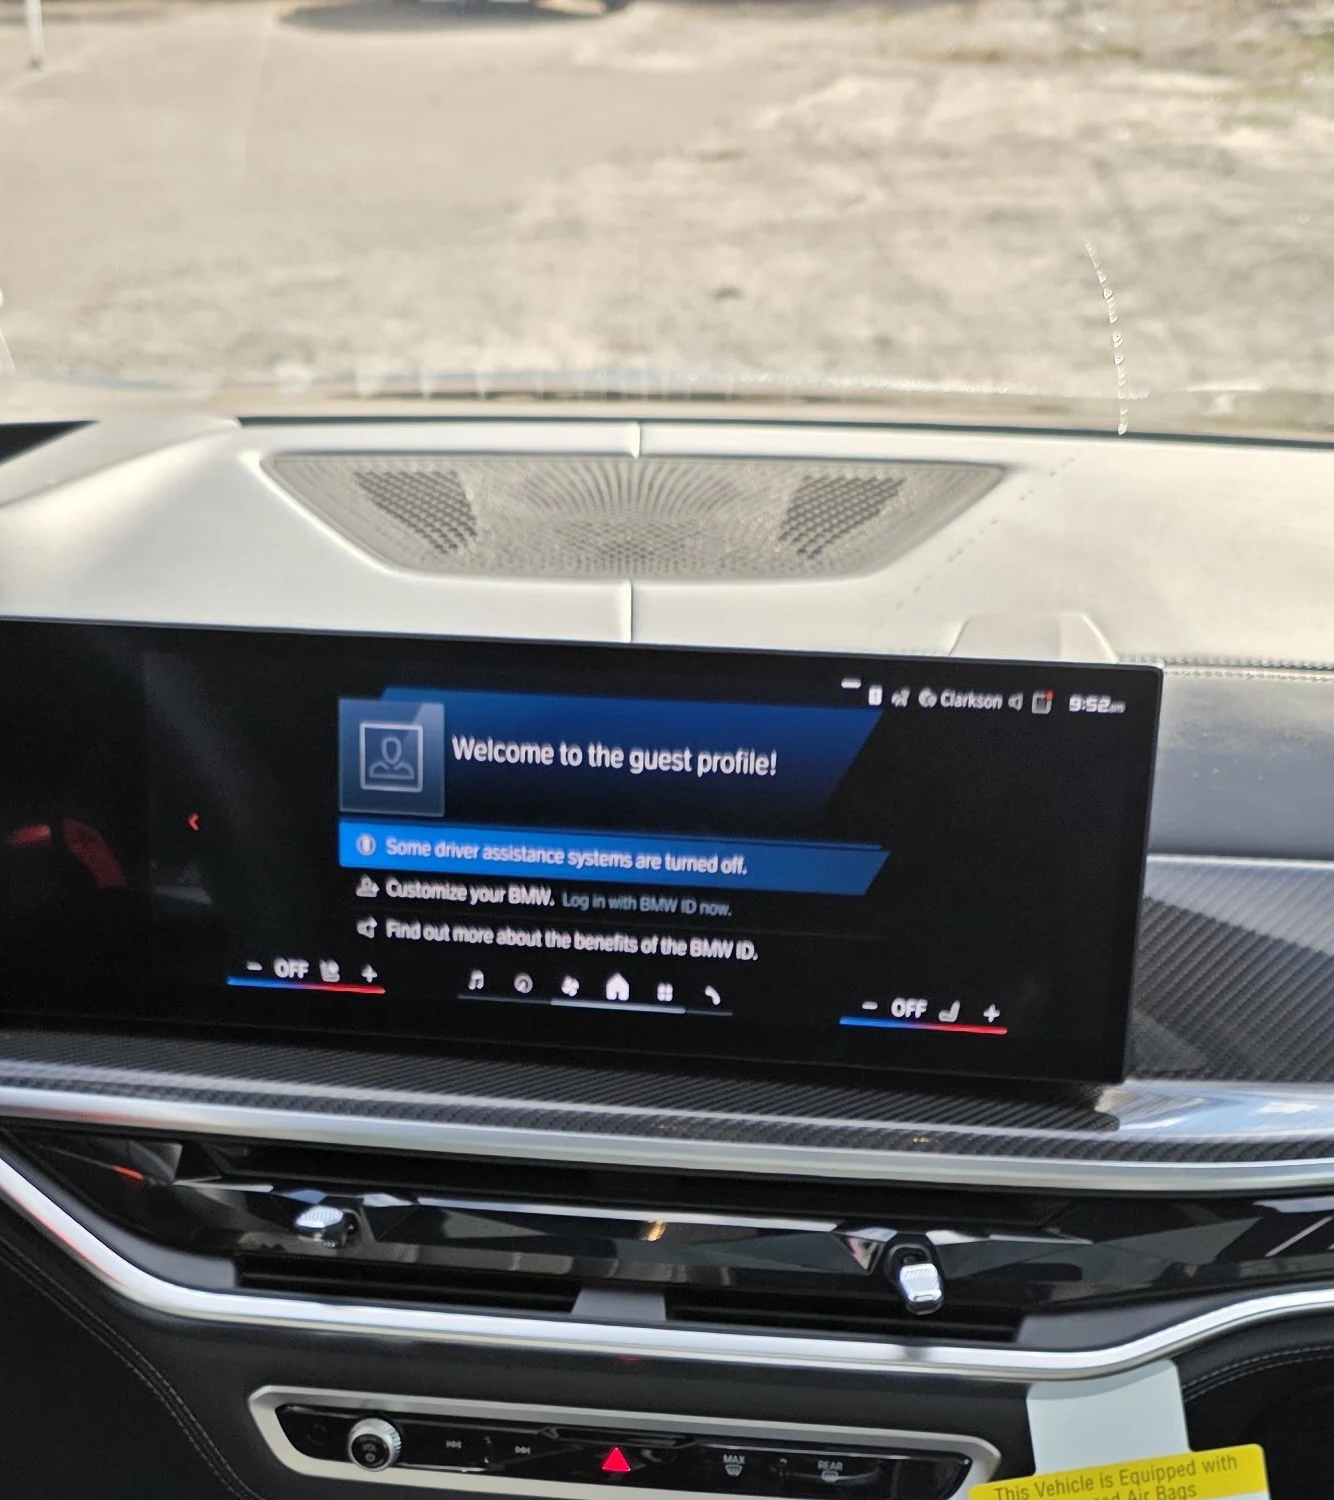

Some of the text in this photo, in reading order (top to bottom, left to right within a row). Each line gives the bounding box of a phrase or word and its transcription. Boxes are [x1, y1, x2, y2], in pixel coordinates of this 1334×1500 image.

[940, 688, 1003, 710] Clarkson
[452, 735, 777, 777] Welcome to the guest profile!
[386, 835, 747, 875] Some driver assistance systems are turned off.
[386, 877, 555, 907] Customize your BMW.
[562, 891, 732, 916] Log in with BMW ID now.
[386, 918, 759, 961] Find out more about the benefits of the BMW ID.
[274, 958, 309, 979] OFF
[890, 998, 927, 1018] OFF
[723, 1454, 746, 1464] MAX
[1034, 1474, 1094, 1498] Vehicle
[1100, 1472, 1114, 1488] is
[1119, 1460, 1197, 1486] Equipped
[1202, 1453, 1238, 1473] with
